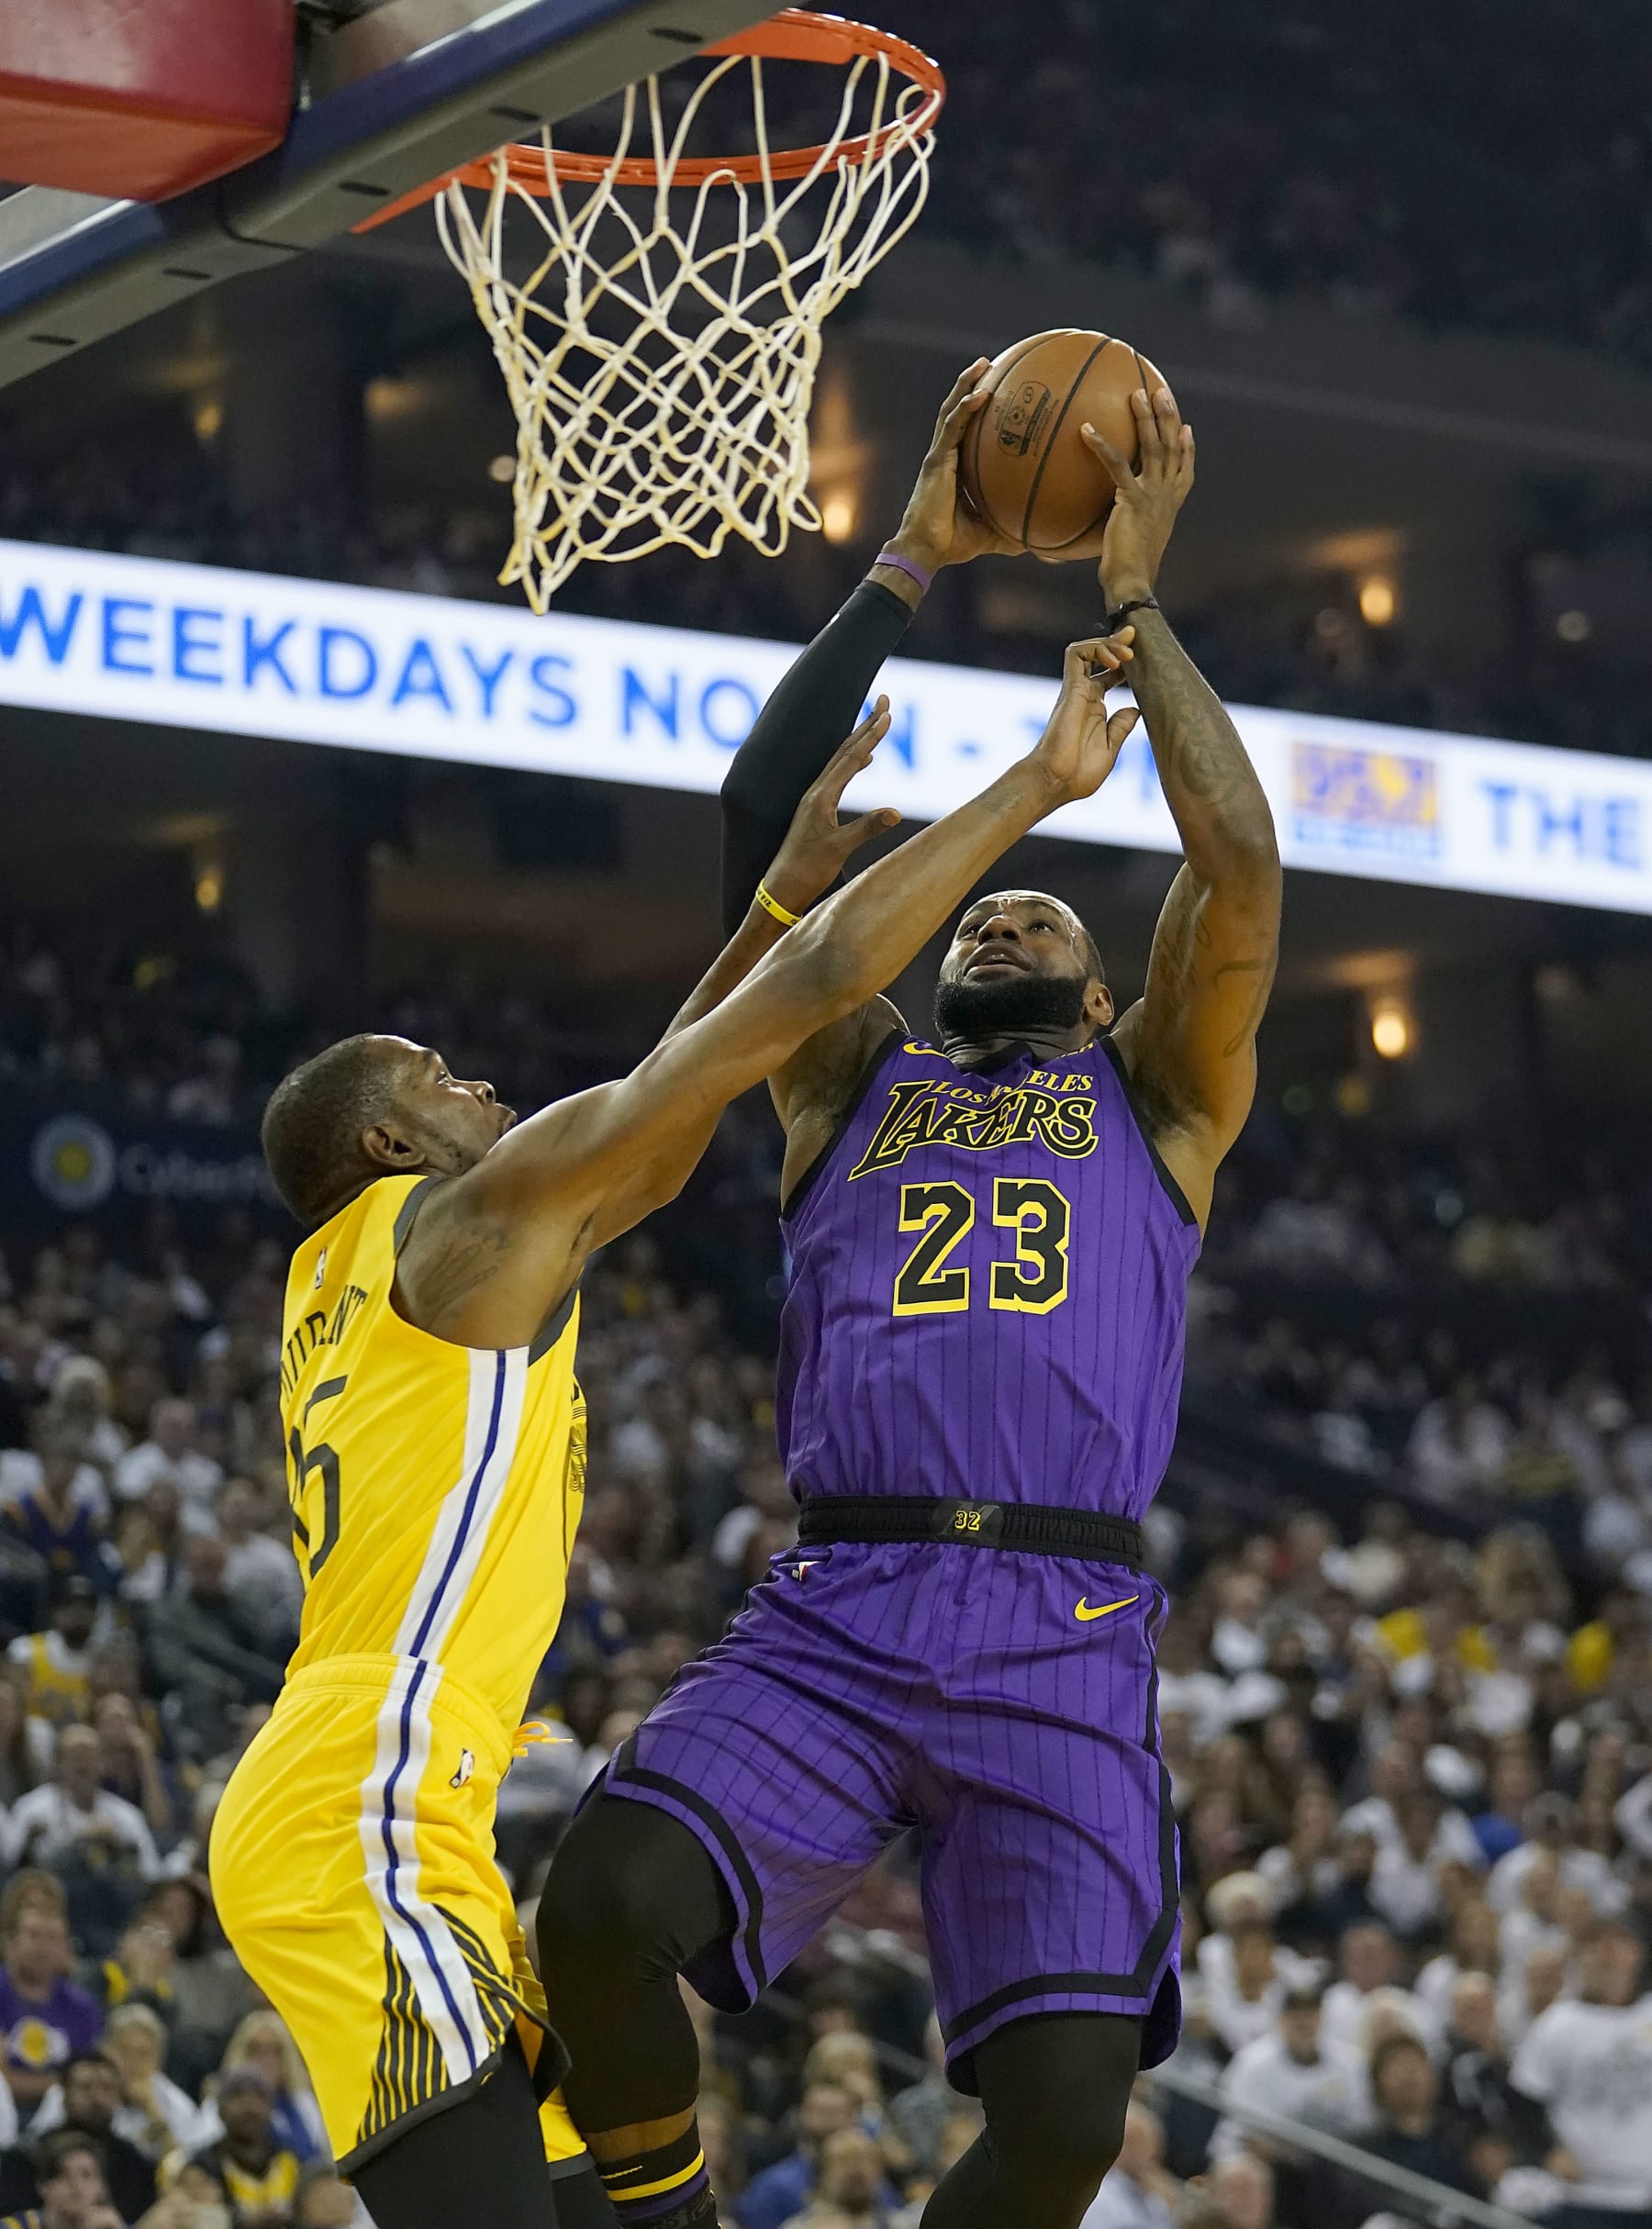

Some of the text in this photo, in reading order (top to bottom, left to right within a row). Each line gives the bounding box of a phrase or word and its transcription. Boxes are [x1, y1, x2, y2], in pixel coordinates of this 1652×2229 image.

[0, 585, 580, 730] WEEKDAYS
[621, 665, 917, 772] NON
[1479, 778, 1642, 870] THE
[846, 1078, 1099, 1182] LAKERS
[930, 1069, 1094, 1107] LOS AELES
[892, 1176, 1071, 1317] 23
[954, 1510, 981, 1532] 32
